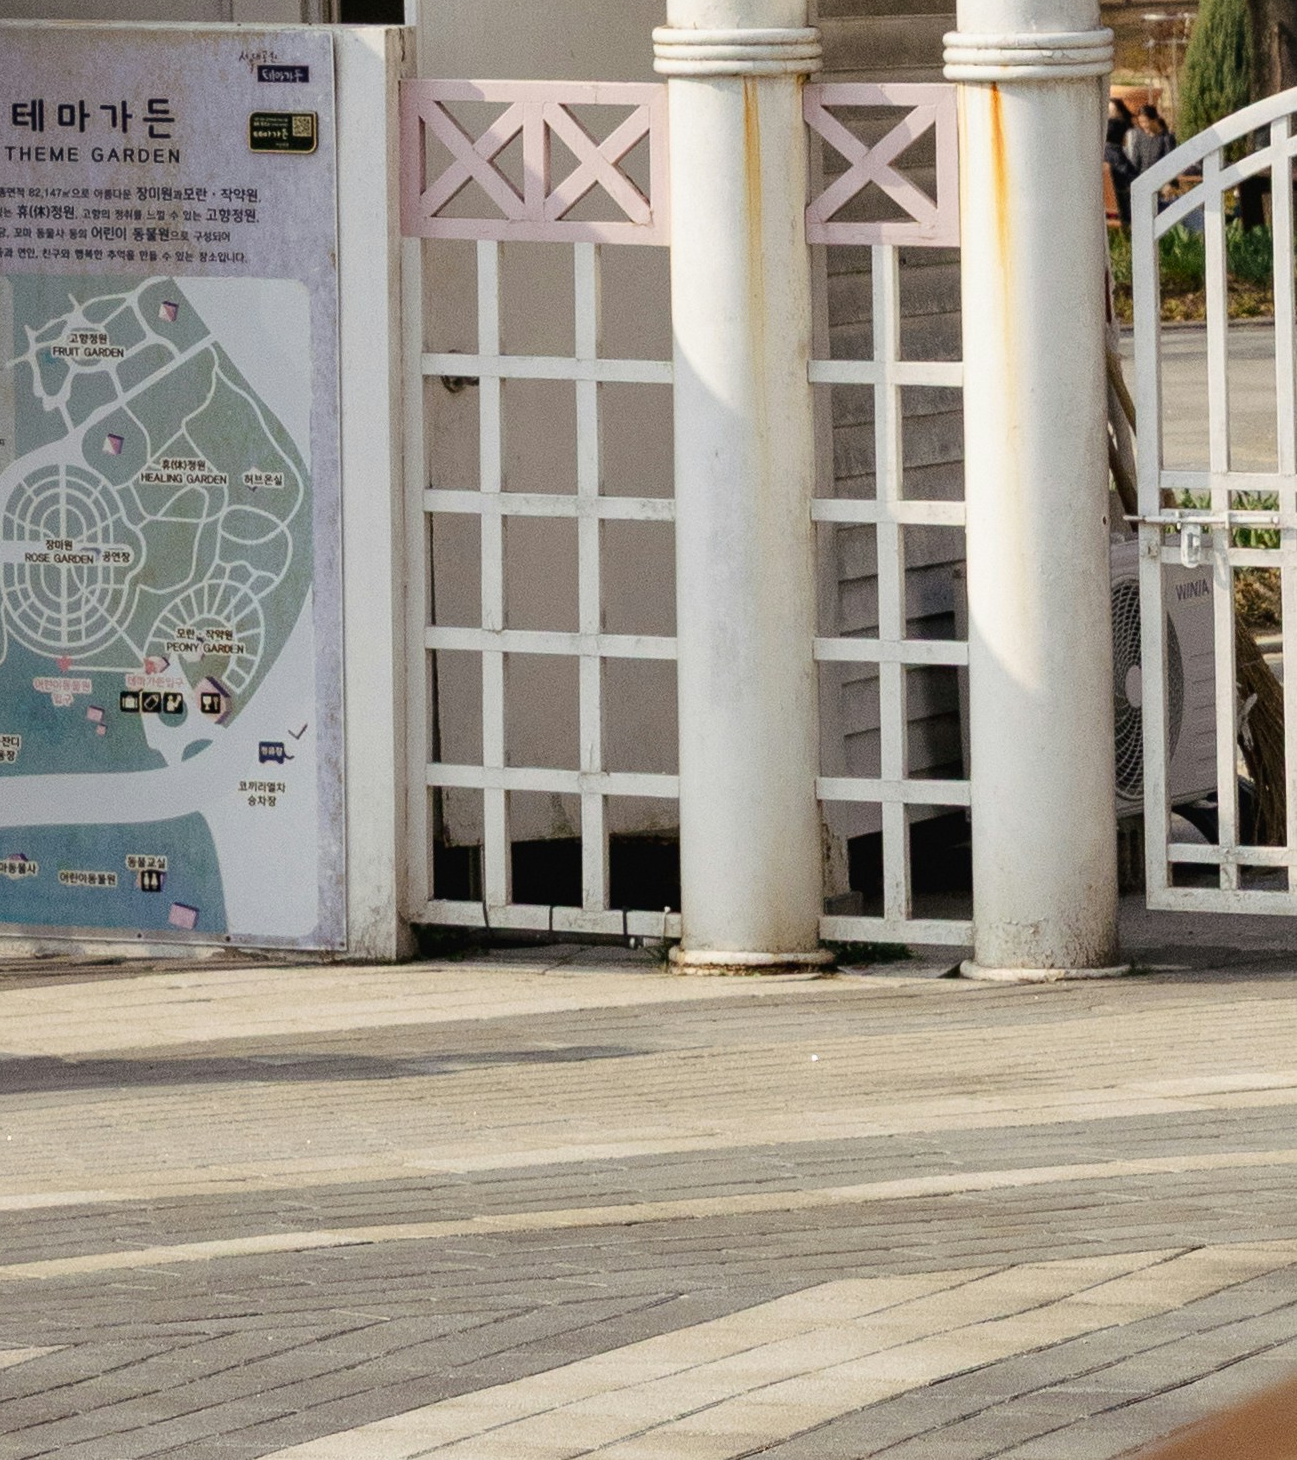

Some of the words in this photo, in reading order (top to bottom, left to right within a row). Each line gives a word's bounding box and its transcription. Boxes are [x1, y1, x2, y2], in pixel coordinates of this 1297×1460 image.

[12, 98, 176, 139] 테마가든
[5, 146, 79, 163] THEME
[91, 147, 181, 164] GARDEN
[170, 210, 179, 221] 수
[182, 210, 201, 222] 있는
[90, 226, 127, 241] 어린이
[162, 252, 172, 262] 수
[175, 252, 195, 263] 있는
[68, 333, 108, 345] 고향정원
[53, 346, 80, 357] FRUIT
[84, 347, 124, 358] GARDEN
[140, 472, 183, 484] HEALING
[186, 474, 228, 485] GARDEN
[45, 539, 73, 552] 장미원
[24, 552, 51, 563] ROSE
[54, 553, 95, 564] GARDEN
[102, 551, 131, 564] 공연장
[1175, 579, 1210, 601] WINIA
[166, 642, 200, 652] PEONY
[203, 644, 244, 654] GARDEN
[238, 781, 286, 794] 코끼리열차
[247, 796, 277, 807] 승차장
[126, 855, 166, 869] 동물교실
[59, 872, 117, 886] 어린이동물원
